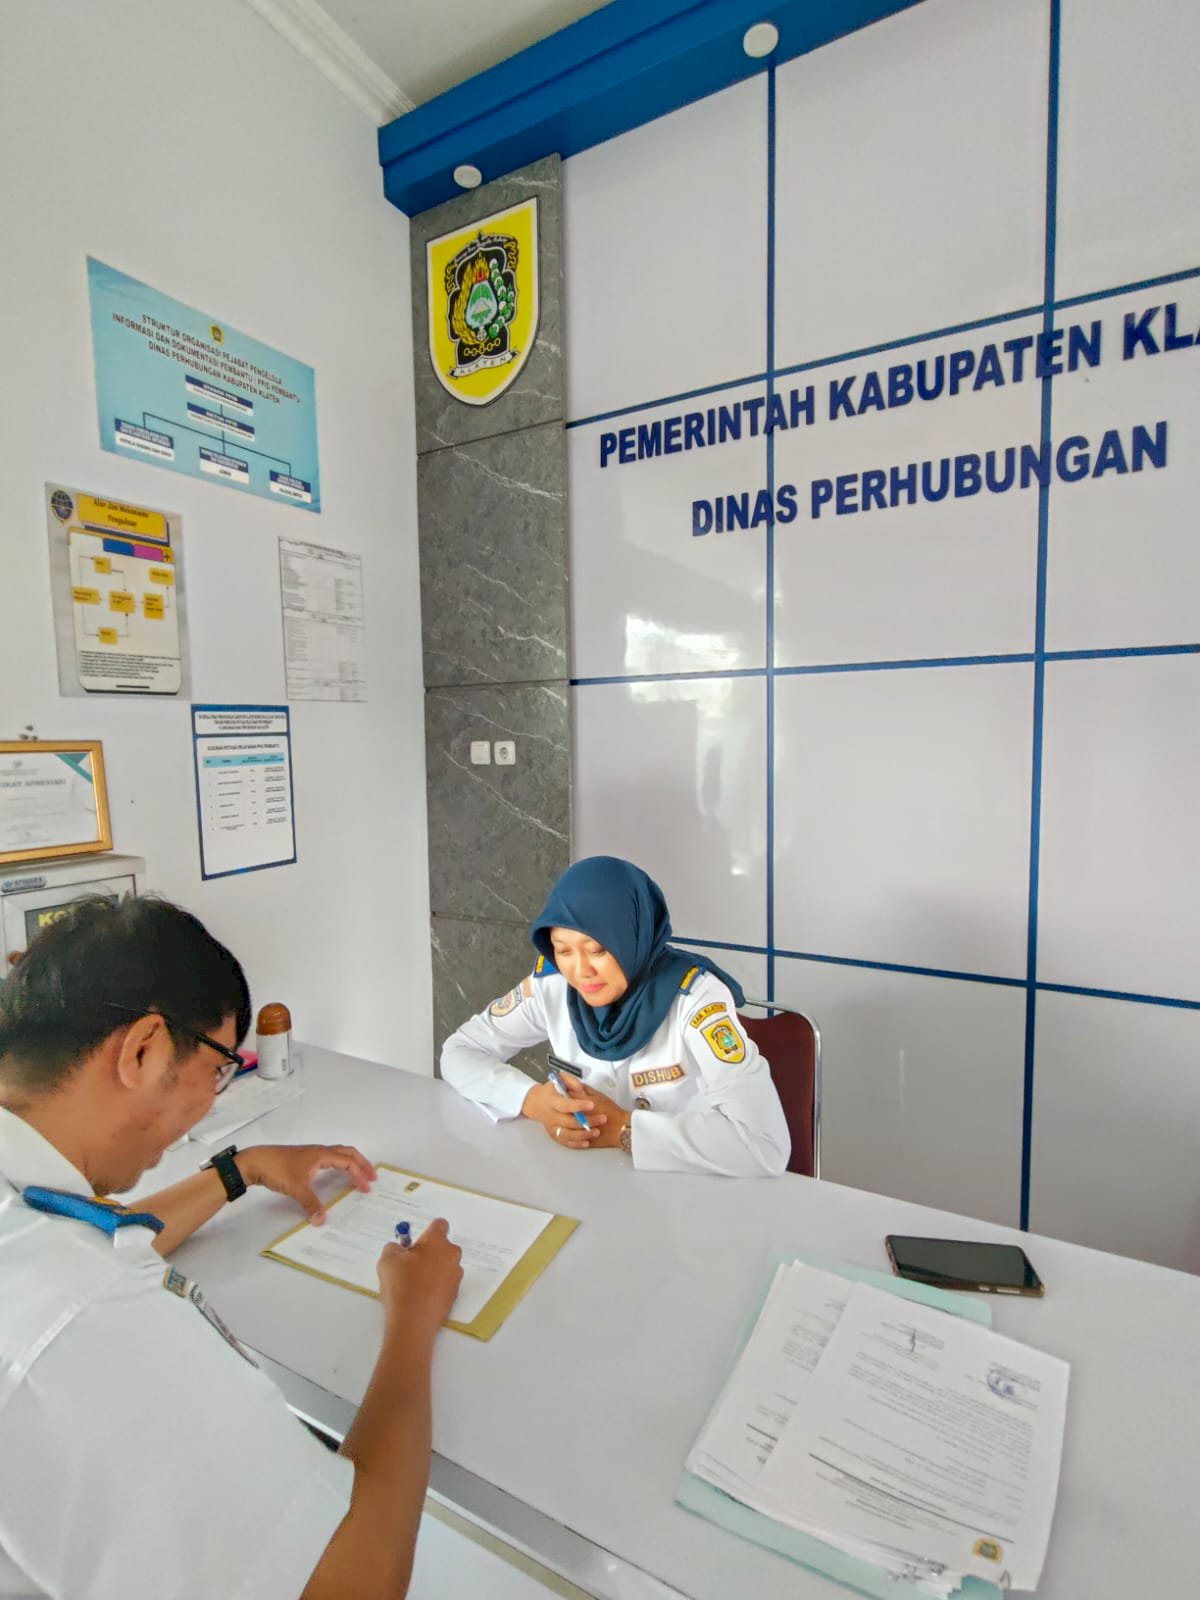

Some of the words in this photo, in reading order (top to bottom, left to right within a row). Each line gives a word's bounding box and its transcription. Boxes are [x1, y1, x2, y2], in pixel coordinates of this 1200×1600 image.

[112, 312, 154, 338] INFORMASI
[155, 331, 170, 345] DAN
[171, 339, 219, 367] DOKUMENTASI
[142, 313, 180, 337] STRUKTUR
[148, 340, 170, 358] DINAS
[171, 350, 222, 378] PERHUBUNGAN
[600, 385, 815, 468] PEMERINTAH
[829, 319, 1102, 421] KABUPATEN
[1123, 302, 1200, 361] KL
[692, 484, 798, 537] DINAS
[811, 420, 1168, 519] PERHUBUNGAN
[634, 1066, 682, 1086] DISHUB
